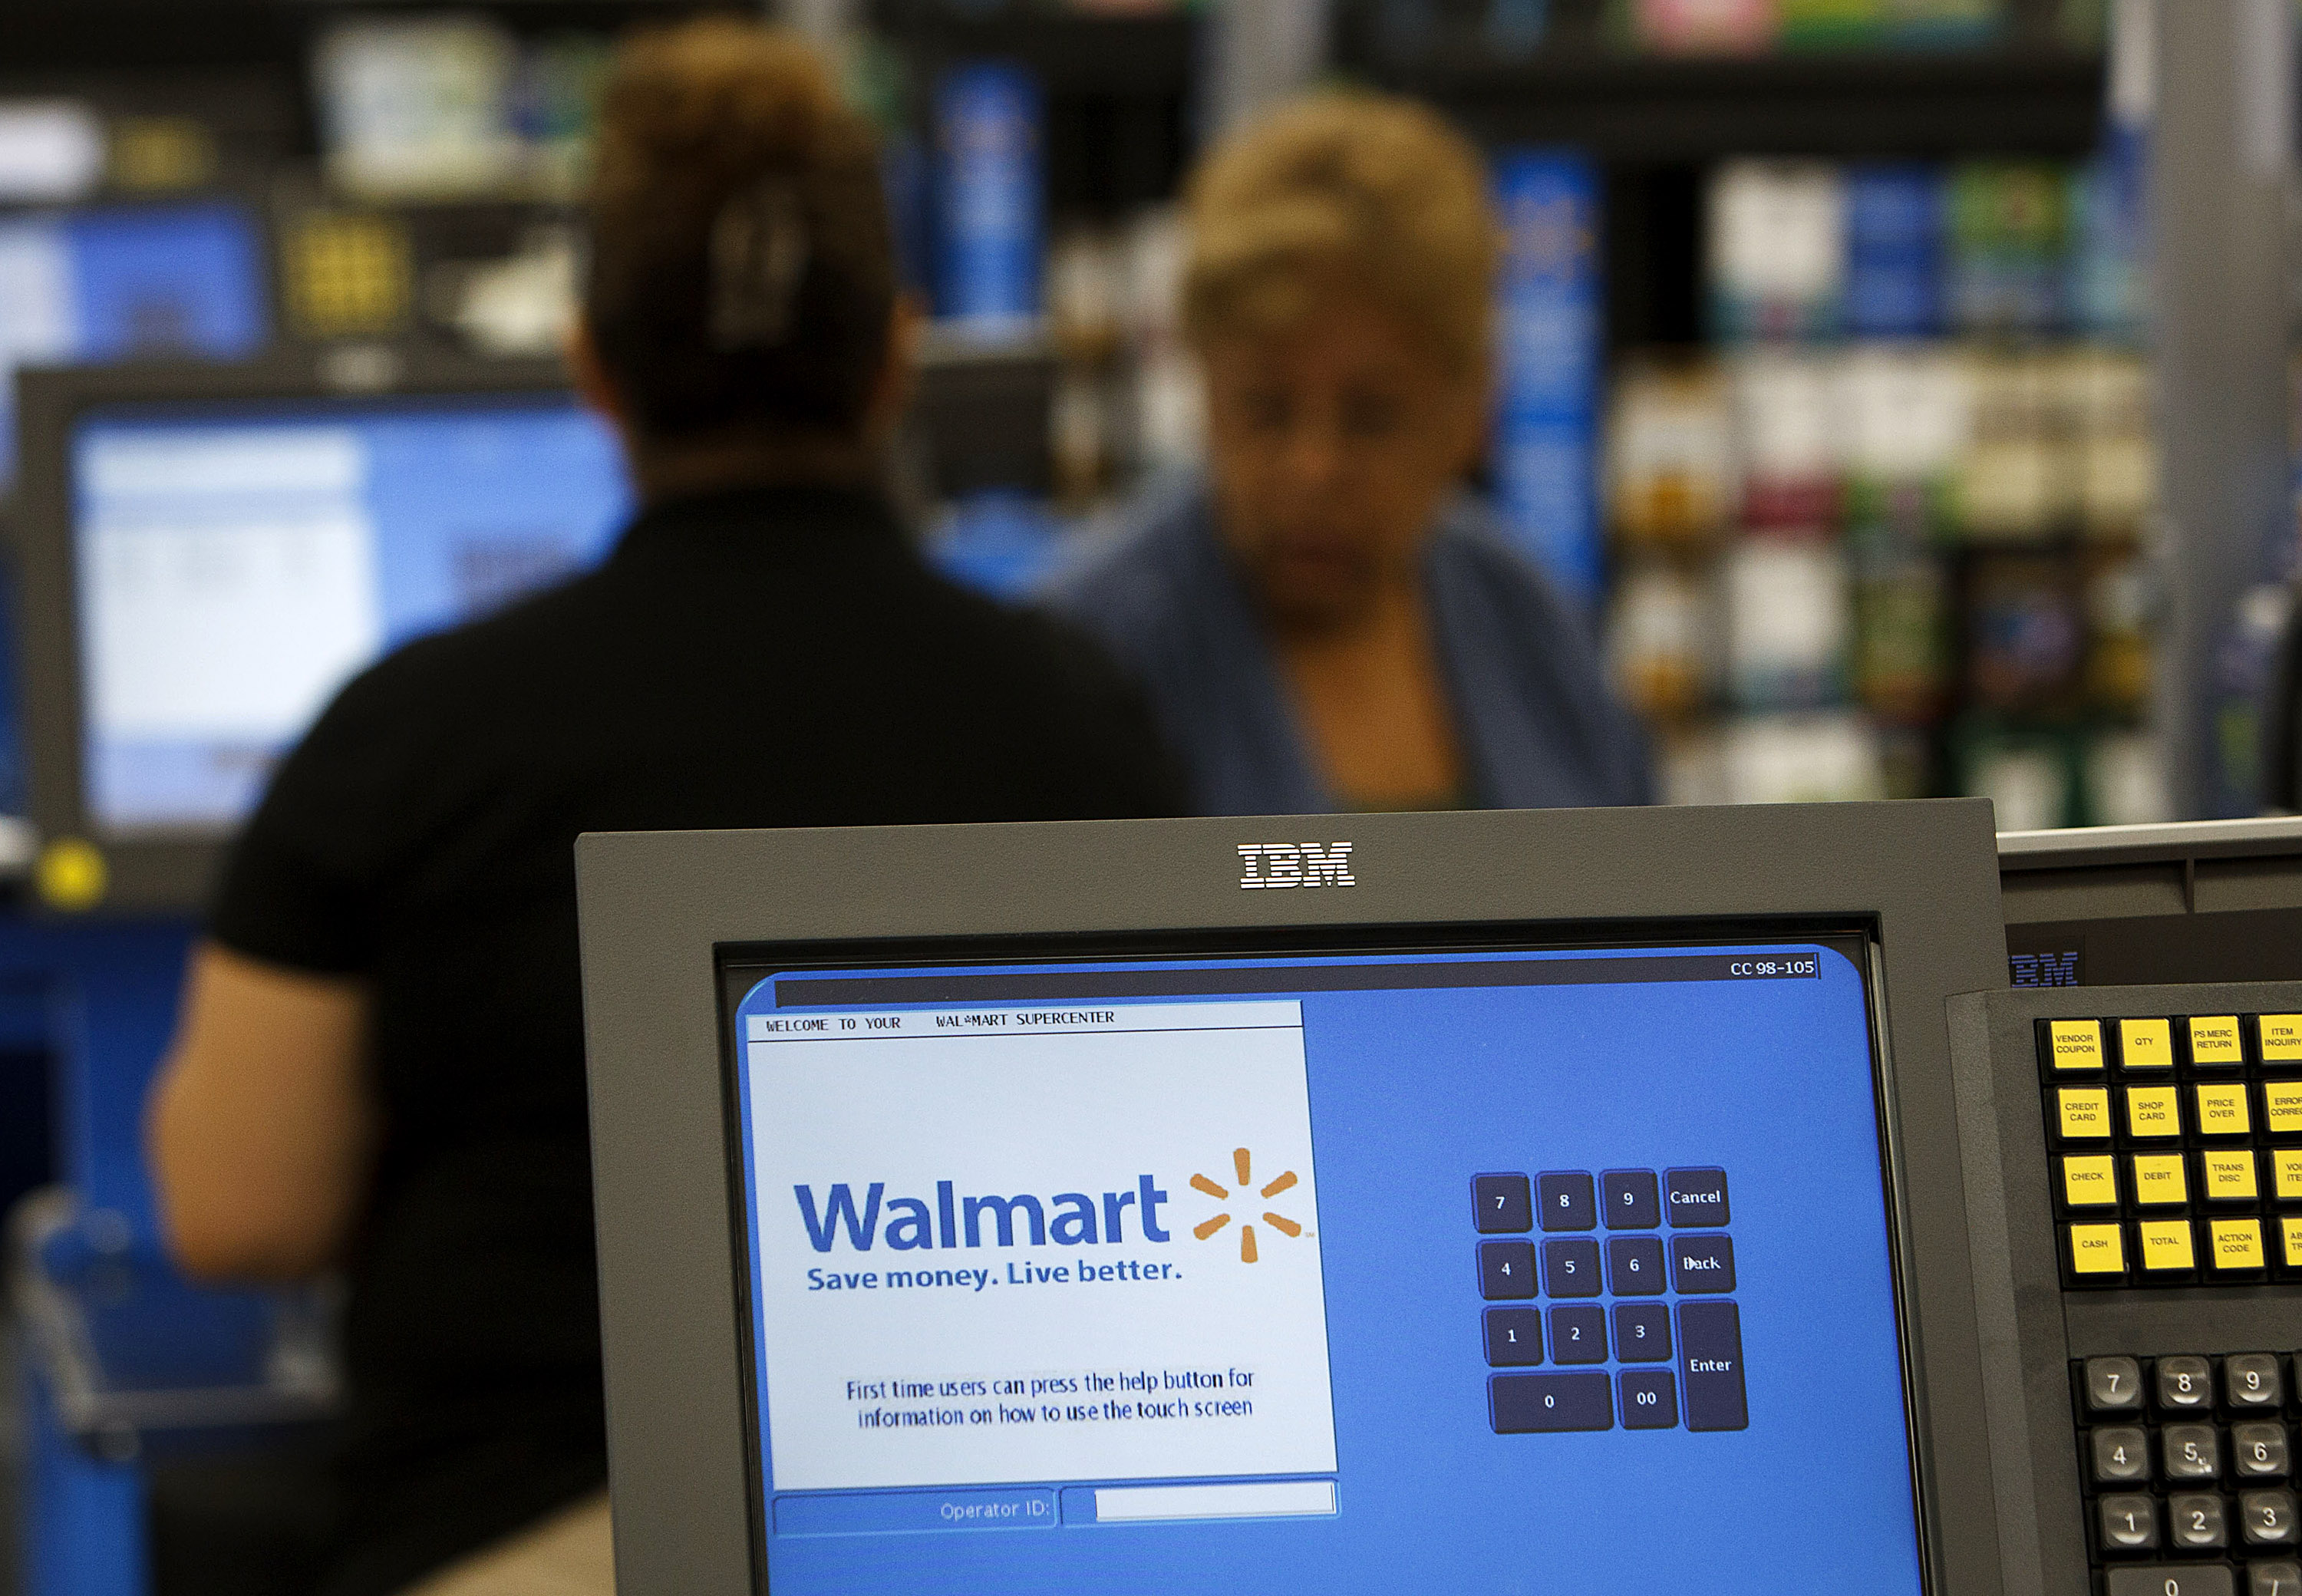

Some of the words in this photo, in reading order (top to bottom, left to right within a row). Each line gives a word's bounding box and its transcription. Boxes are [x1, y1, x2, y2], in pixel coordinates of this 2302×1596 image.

[1237, 842, 1356, 889] IBM
[1730, 962, 1753, 975] CC
[1756, 961, 1815, 974] 98-105
[2008, 952, 2078, 988] BM
[767, 1018, 829, 1032] WELCOME
[839, 1018, 856, 1030] TO
[866, 1017, 901, 1030] YOUR
[1017, 1011, 1115, 1026] SUPERCENTER
[2056, 1034, 2093, 1043] VENDOR
[2194, 1030, 2205, 1038] PS
[2207, 1029, 2232, 1037] MERC
[2271, 1027, 2294, 1036] ITEM
[2135, 1037, 2153, 1046] QTY
[2197, 1040, 2232, 1049] RETURN
[2264, 1038, 2301, 1047] INQUIRY
[2056, 1045, 2095, 1054] COUPON
[2138, 1101, 2164, 1110] SHOP
[2271, 1107, 2302, 1116] CORRE
[2209, 1110, 2234, 1118] OVER
[2212, 1163, 2244, 1172] TRANS
[2071, 1172, 2104, 1181] CHECK
[2144, 1172, 2171, 1180] DEBIT
[2218, 1174, 2241, 1182] DISC
[1495, 1195, 1506, 1210] 7
[1559, 1194, 1570, 1208] 8
[1623, 1192, 1634, 1206] 9
[1670, 1189, 1721, 1204] Cancel
[793, 1175, 1170, 1253] Walmart
[2082, 1240, 2108, 1248] CASH
[2150, 1236, 2179, 1245] TOTAL
[2218, 1233, 2252, 1242] ACTION
[2223, 1244, 2249, 1253] CODE
[1501, 1262, 1511, 1275] 4
[1565, 1261, 1575, 1274] 5
[1629, 1258, 1639, 1272] 6
[807, 1268, 878, 1291] Save
[886, 1268, 998, 1292] money.
[1007, 1261, 1070, 1284] Live
[1078, 1259, 1182, 1283] better.
[1508, 1329, 1517, 1343] 1
[1571, 1327, 1581, 1340] 2
[1635, 1324, 1645, 1338] 3
[1690, 1358, 1732, 1372] Enter
[847, 1381, 887, 1400] First
[892, 1380, 934, 1398] time
[939, 1380, 987, 1396] users
[994, 1379, 1024, 1394] can
[1031, 1377, 1078, 1397] press
[1085, 1372, 1114, 1392] the
[1120, 1370, 1158, 1393] help
[1164, 1370, 1224, 1390] button
[1229, 1368, 1254, 1387] for
[2107, 1373, 2120, 1393] 7
[2178, 1373, 2192, 1392] 8
[2245, 1370, 2261, 1390] 9
[1544, 1394, 1555, 1408] 0
[1637, 1392, 1657, 1406] 00
[859, 1407, 964, 1428] information
[970, 1409, 992, 1425] on
[999, 1403, 1035, 1424] how
[1041, 1405, 1060, 1422] to
[1067, 1404, 1098, 1420] use
[1103, 1400, 1132, 1420] the
[1137, 1397, 1189, 1419] touch
[1195, 1400, 1252, 1417] screen
[2113, 1446, 2126, 1465] 4
[2184, 1442, 2198, 1462] 5
[2254, 1442, 2267, 1462] 6
[941, 1502, 1020, 1522] Operator
[1027, 1499, 1050, 1516] ID:
[2263, 1507, 2277, 1527] 3
[2124, 1512, 2135, 1532] 1
[2192, 1510, 2207, 1531] 2
[2165, 1579, 2178, 1596] 0
